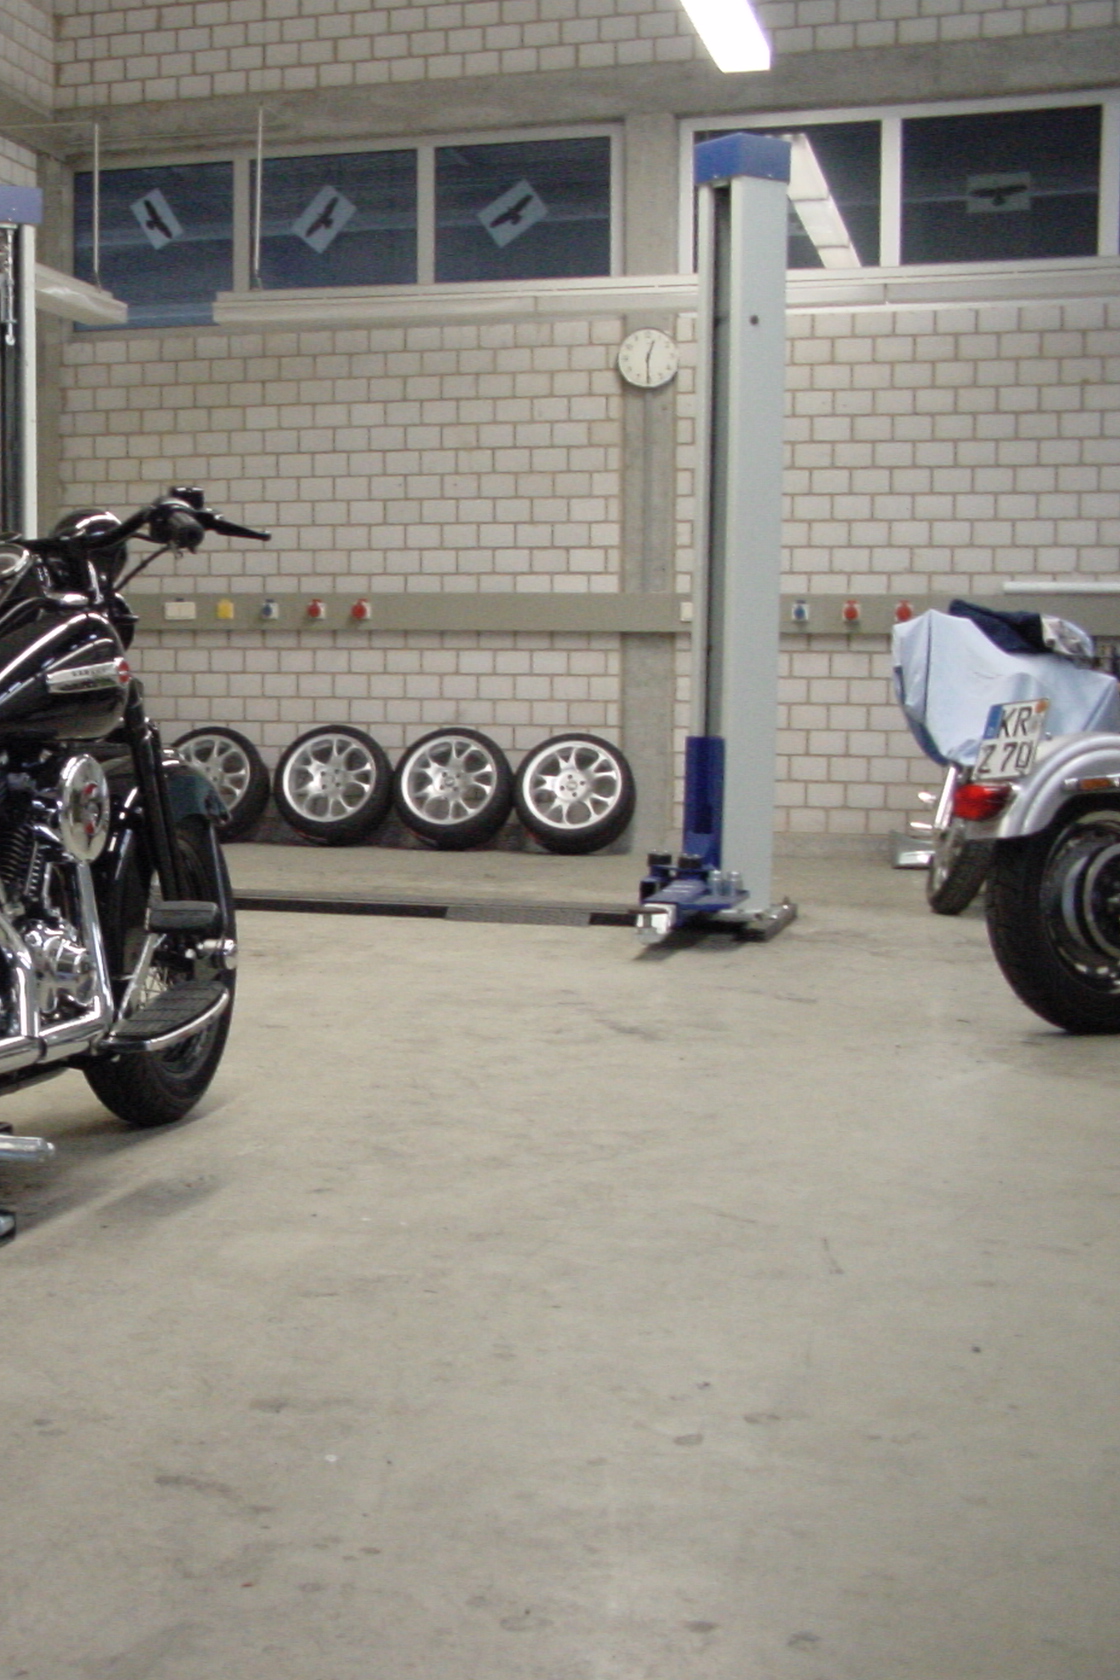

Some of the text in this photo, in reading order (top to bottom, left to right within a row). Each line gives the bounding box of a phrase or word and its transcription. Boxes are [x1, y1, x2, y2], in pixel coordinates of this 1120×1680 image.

[997, 706, 1032, 738] KR
[977, 741, 1034, 773] Z 70
